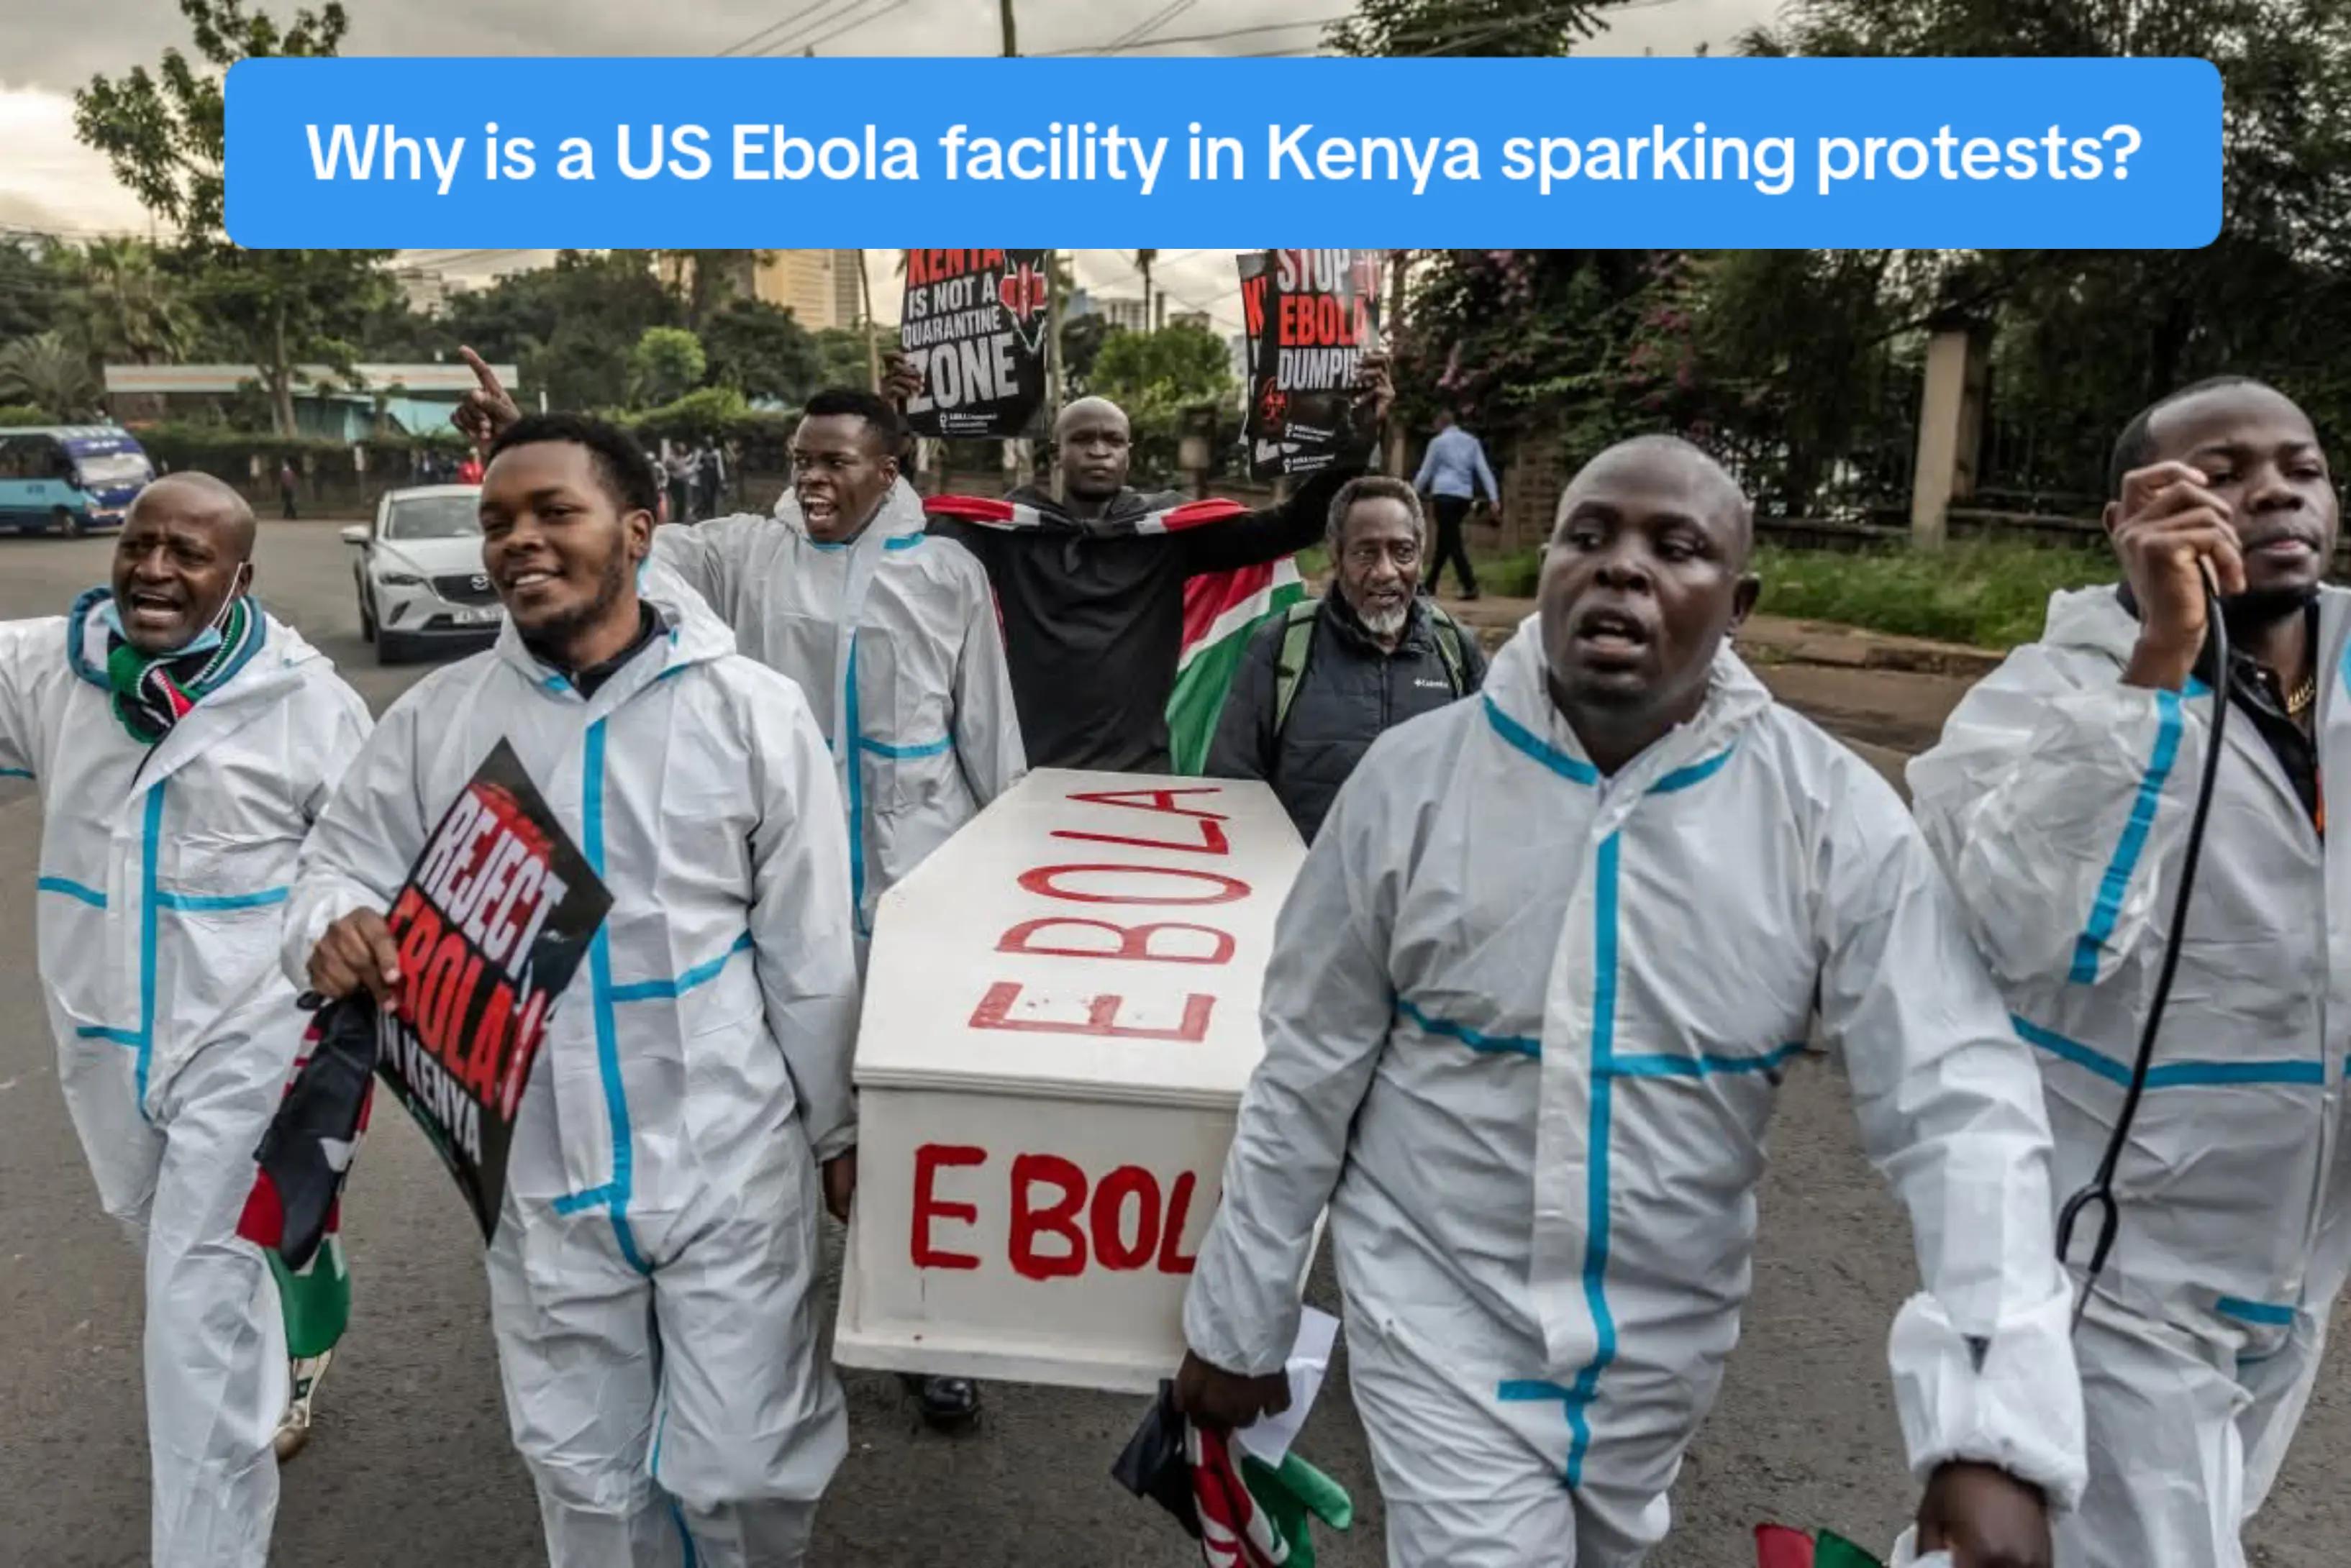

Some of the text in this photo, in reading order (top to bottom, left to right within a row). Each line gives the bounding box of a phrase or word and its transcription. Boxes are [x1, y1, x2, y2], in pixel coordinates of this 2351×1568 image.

[909, 271, 998, 321] IS NOT A
[1276, 249, 1350, 293] STOP
[902, 305, 1002, 350] QUARANTINE
[1279, 294, 1370, 346] EBOLA
[904, 333, 1019, 414] ZONE
[1277, 347, 1365, 390] DUMPIN
[415, 789, 569, 982] REJECT
[968, 787, 1252, 1043] EBOLA
[403, 1029, 483, 1166] KENYA
[911, 1143, 1198, 1281] EBOL
